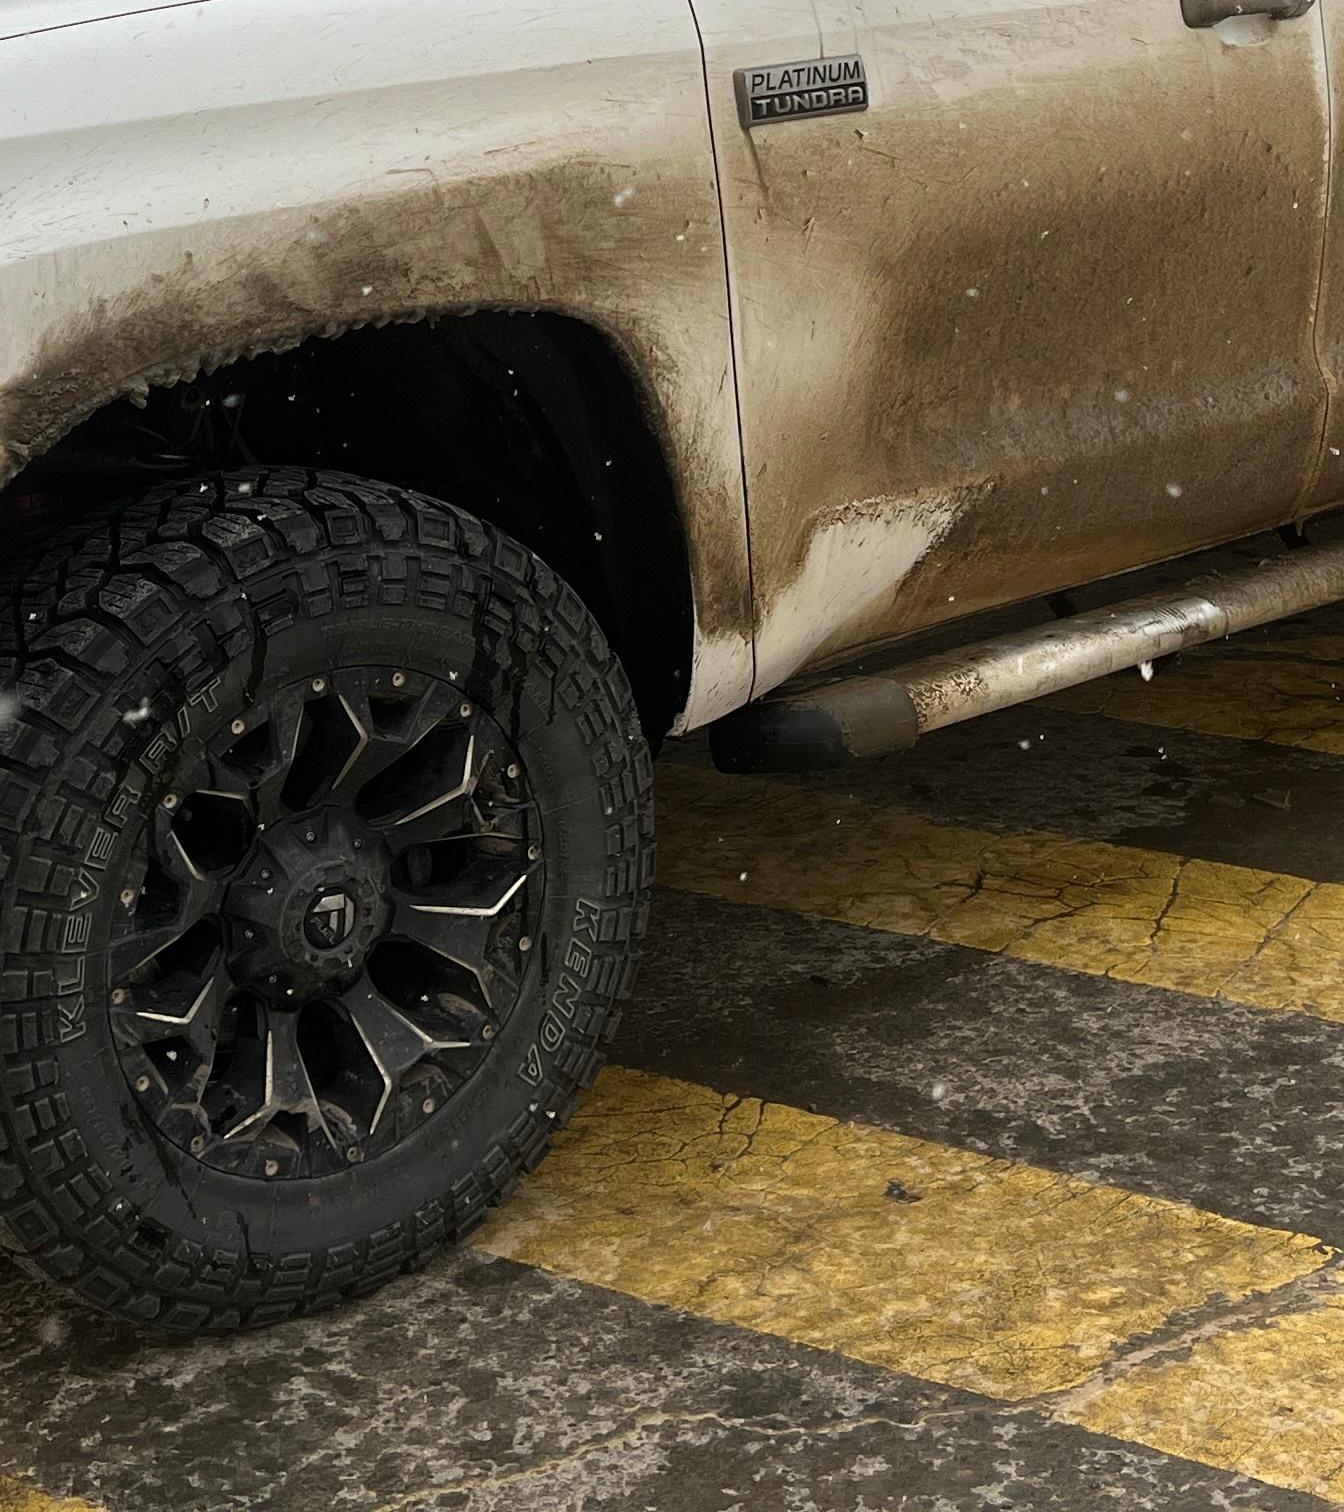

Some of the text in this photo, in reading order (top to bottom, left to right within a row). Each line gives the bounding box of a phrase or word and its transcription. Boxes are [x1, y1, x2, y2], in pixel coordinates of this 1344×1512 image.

[750, 60, 861, 93] PLATINUM
[755, 85, 864, 116] TUNDRA
[58, 777, 143, 1044] KLEVER
[517, 897, 602, 1088] KENDA
